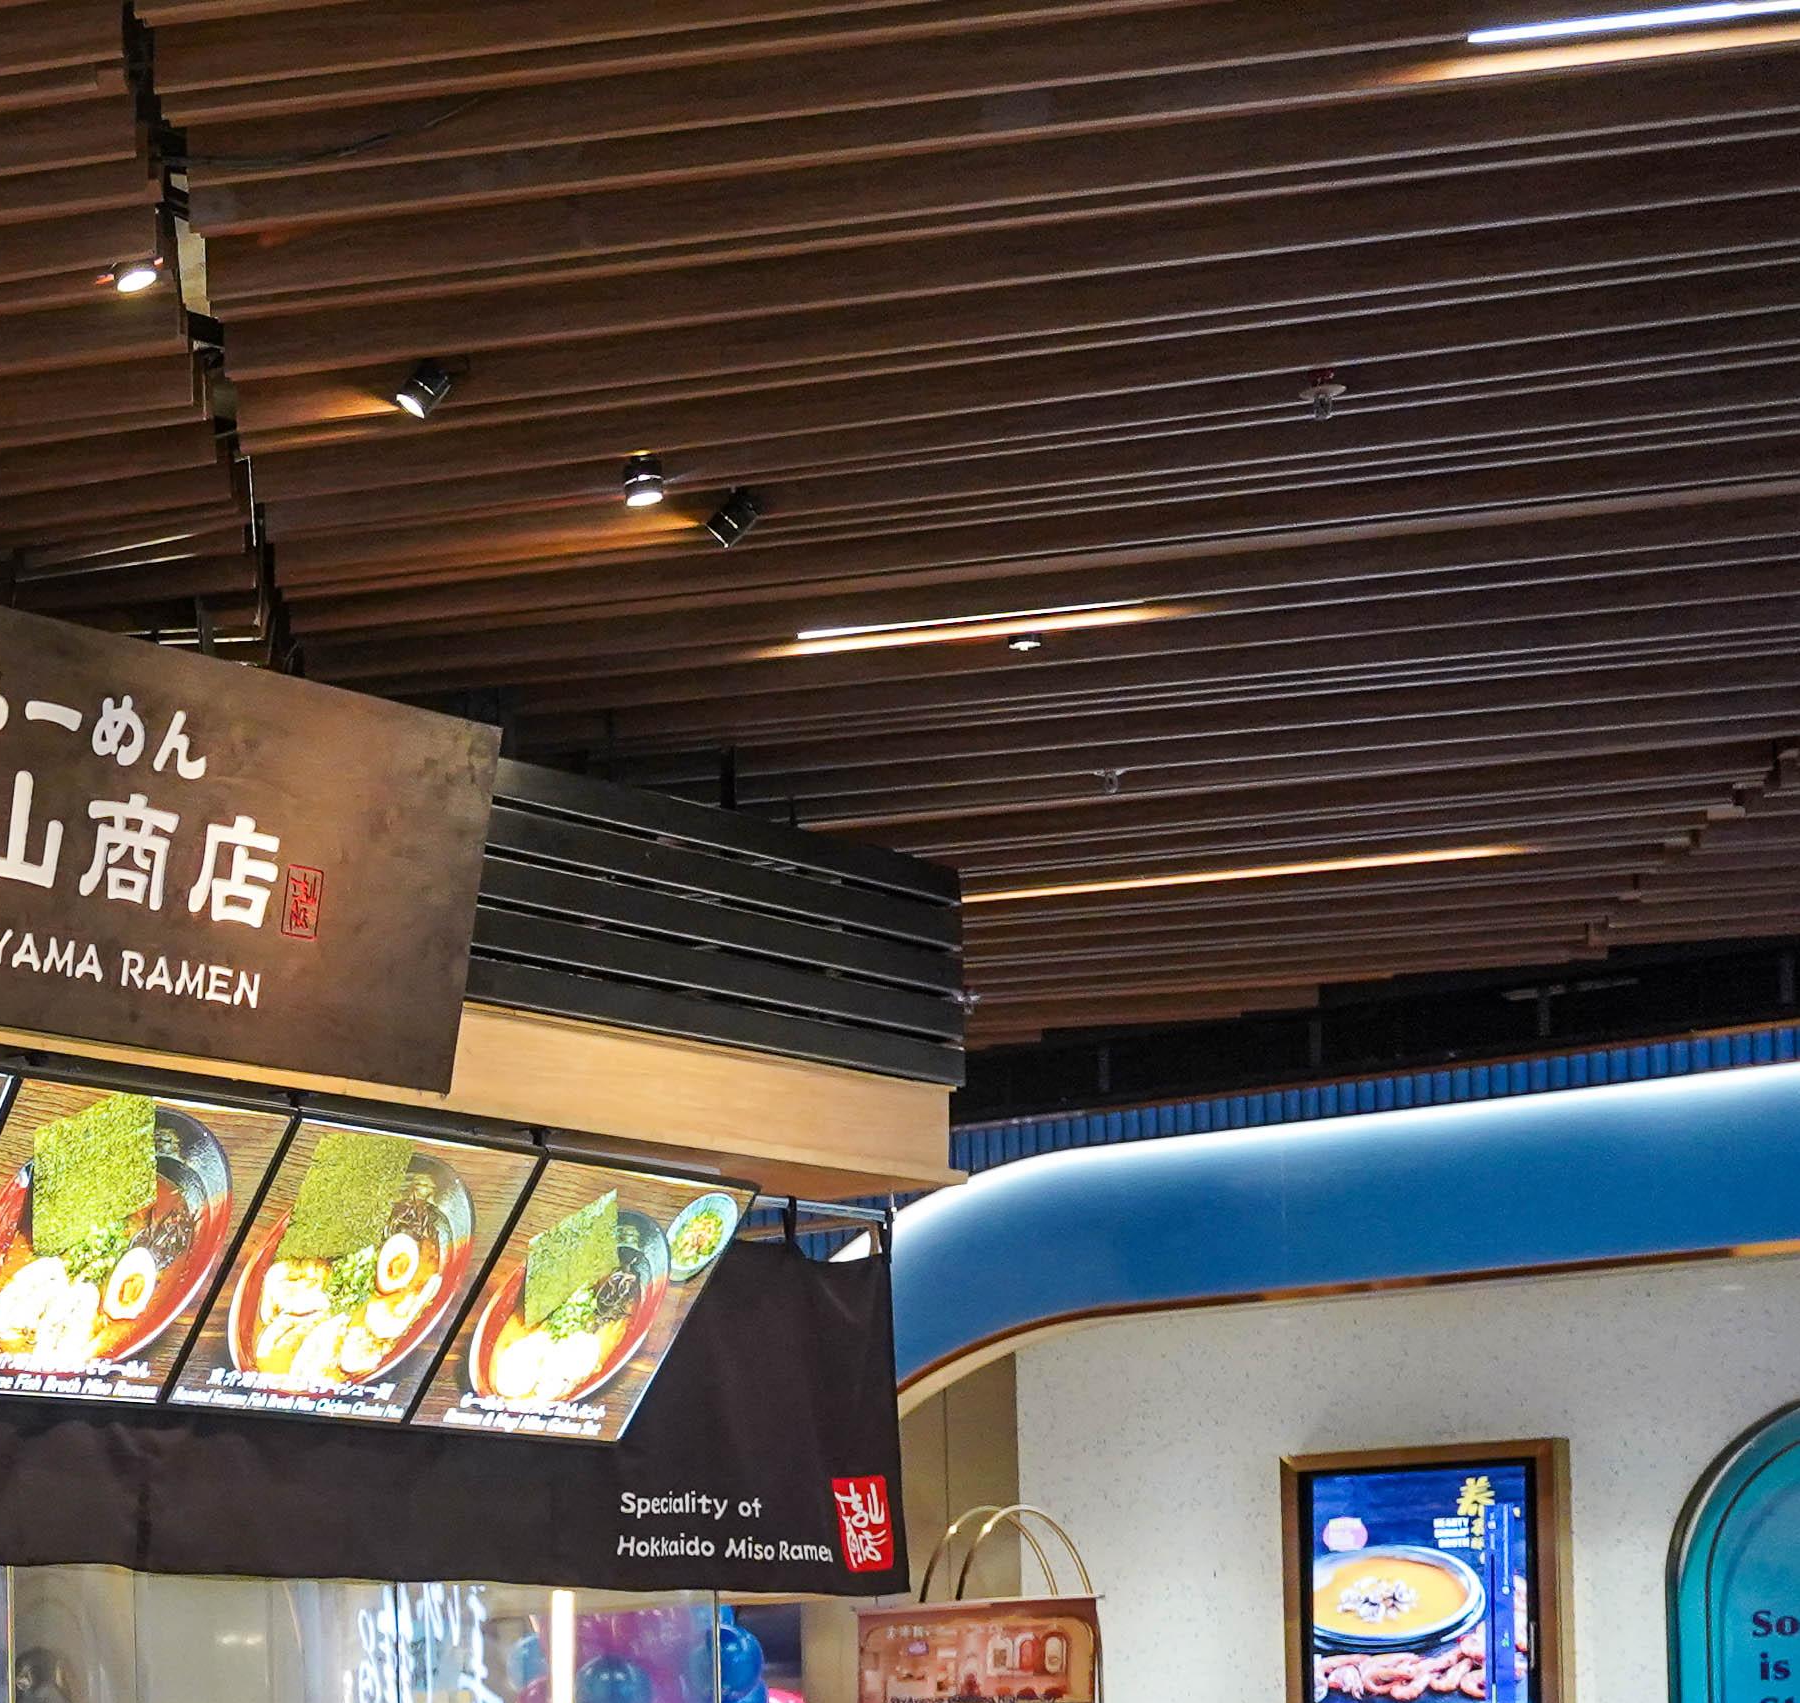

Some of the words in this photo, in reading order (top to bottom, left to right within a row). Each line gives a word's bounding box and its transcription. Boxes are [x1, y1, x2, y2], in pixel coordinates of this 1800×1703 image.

[121, 949, 261, 1009] RAMEN
[14, 1374, 42, 1391] Fish
[81, 1378, 112, 1396] Miso
[620, 1490, 728, 1520] Speciality
[737, 1497, 762, 1518] of
[617, 1533, 715, 1558] Hokkaido
[724, 1536, 775, 1561] Miso
[1760, 1652, 1791, 1681] is
